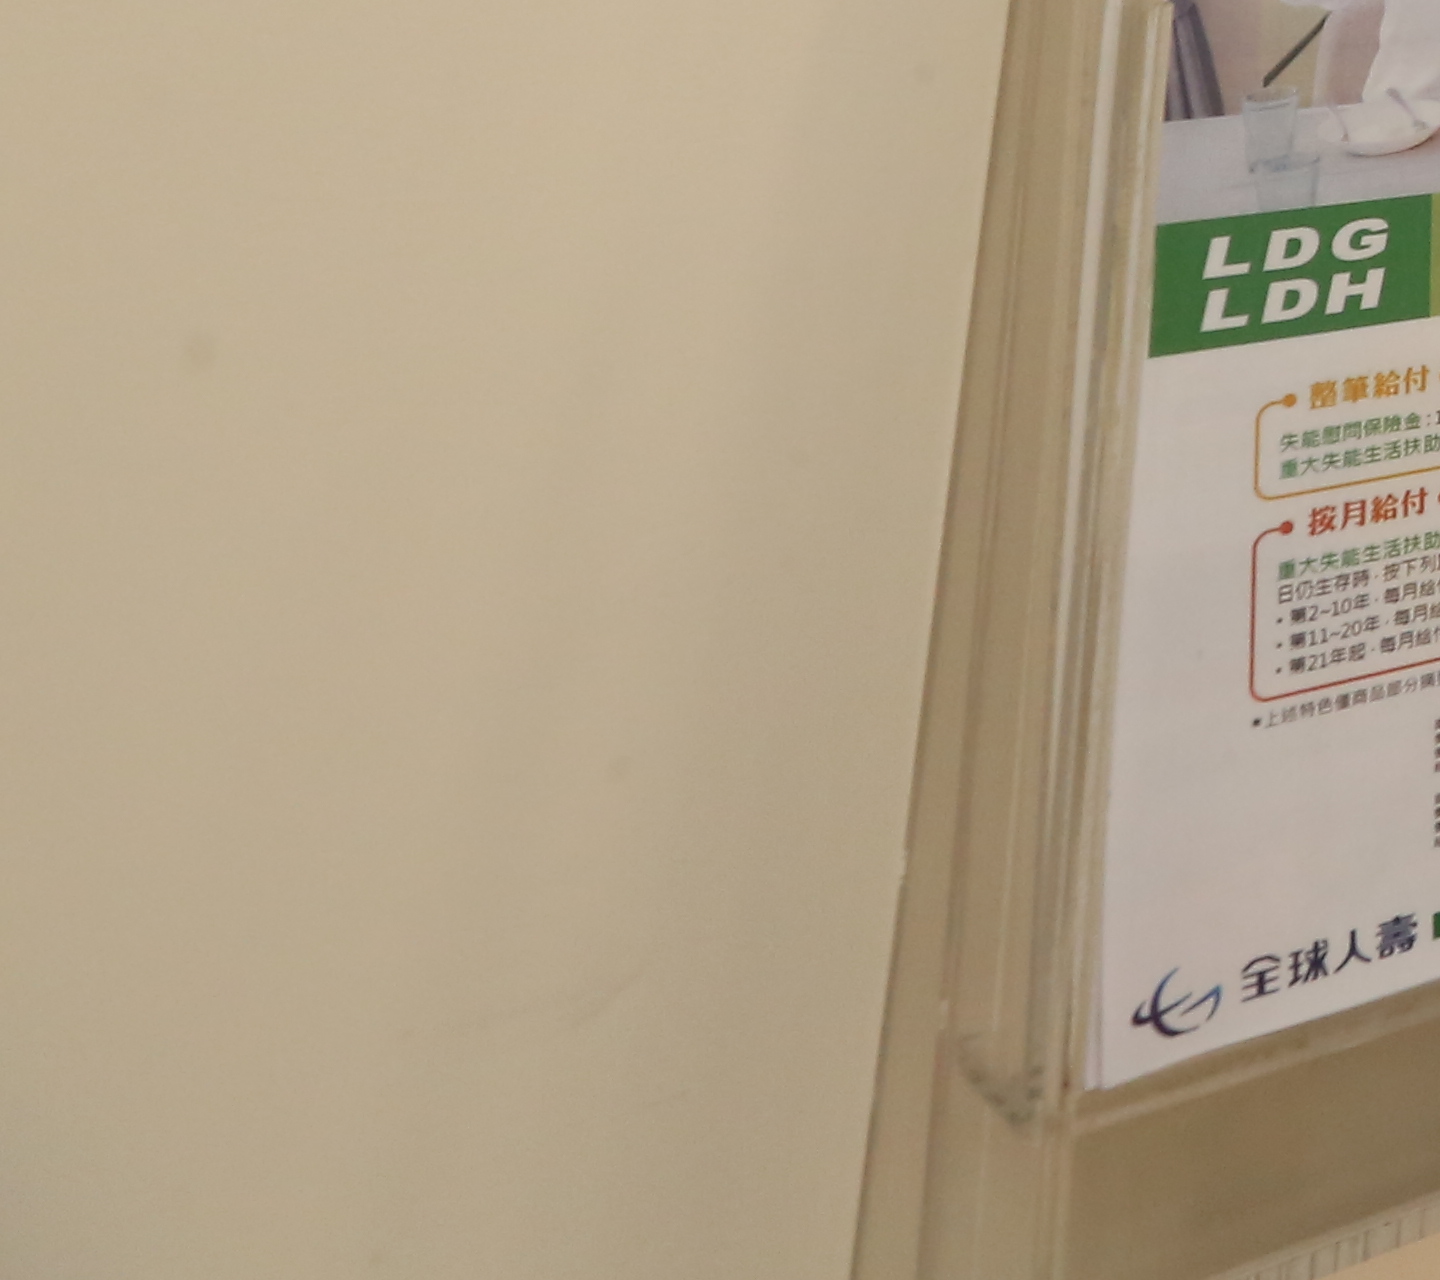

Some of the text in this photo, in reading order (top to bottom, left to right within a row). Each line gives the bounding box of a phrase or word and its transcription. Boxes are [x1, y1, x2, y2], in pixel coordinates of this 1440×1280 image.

[1201, 217, 1390, 282] LDG
[1200, 267, 1386, 333] LDH
[1309, 364, 1431, 410] 整筆給付
[1307, 487, 1429, 536] 按月給付
[1240, 913, 1419, 1003] 全球人壽
